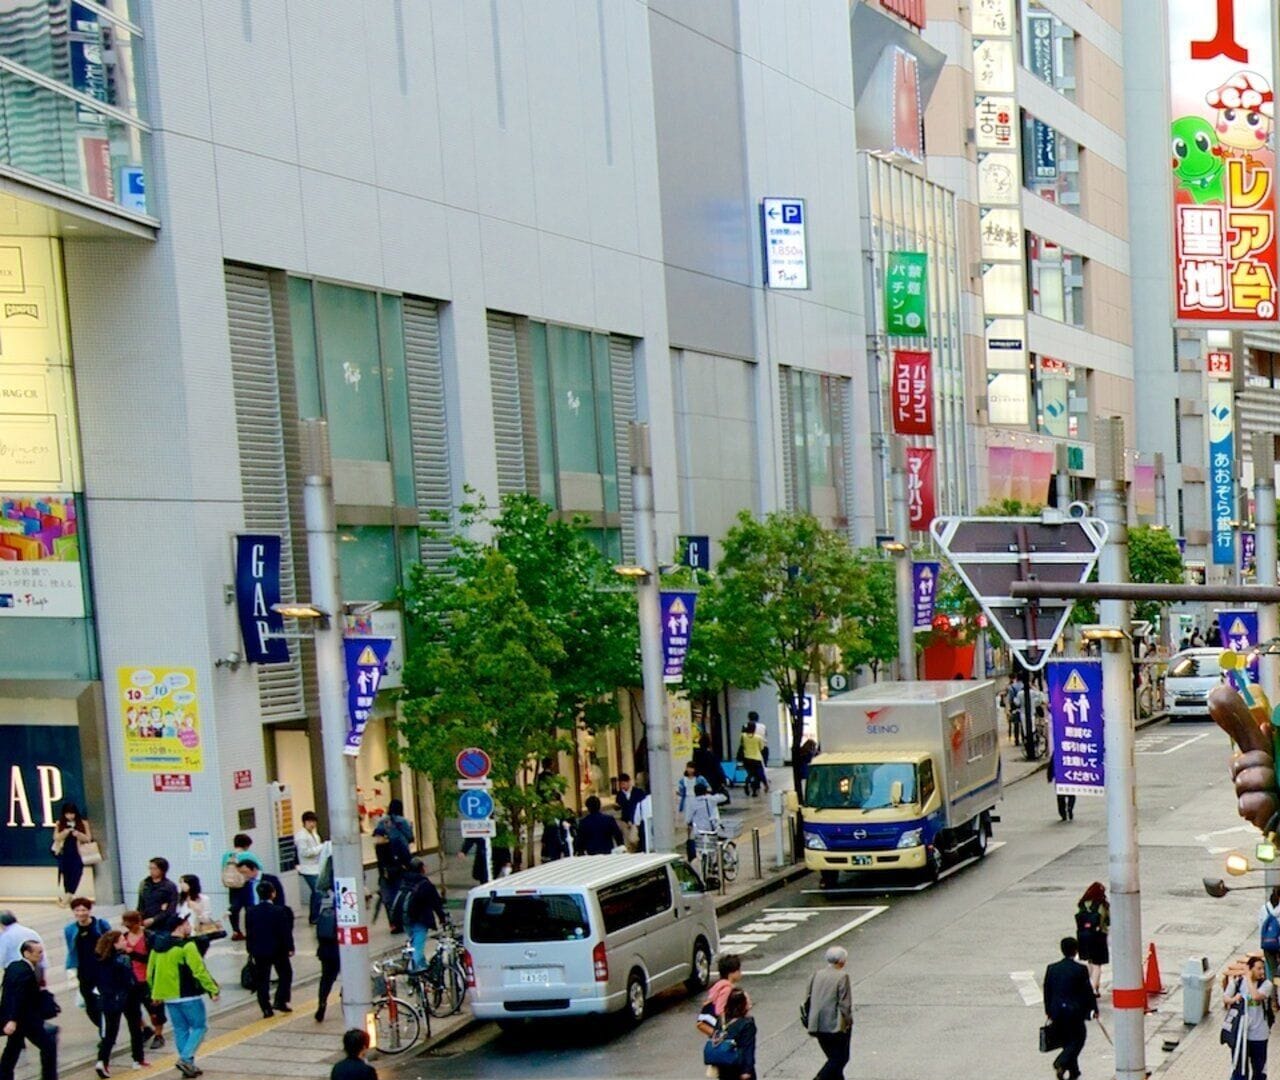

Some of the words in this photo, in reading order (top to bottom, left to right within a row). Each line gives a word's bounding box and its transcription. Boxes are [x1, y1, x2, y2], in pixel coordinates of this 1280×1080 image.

[786, 207, 798, 222] P
[1226, 158, 1275, 319] レア台の
[1180, 204, 1226, 311] 聖地
[897, 364, 911, 422] スロット
[912, 364, 927, 424] パチンコ
[907, 457, 923, 523] マルハン
[1213, 451, 1232, 550] あおぞら銀行
[251, 543, 270, 656] GAP
[865, 725, 899, 735] SEINO
[1062, 755, 1098, 769] 注意して
[1063, 768, 1100, 783] ください
[6, 764, 64, 829] AP
[467, 796, 480, 816] P
